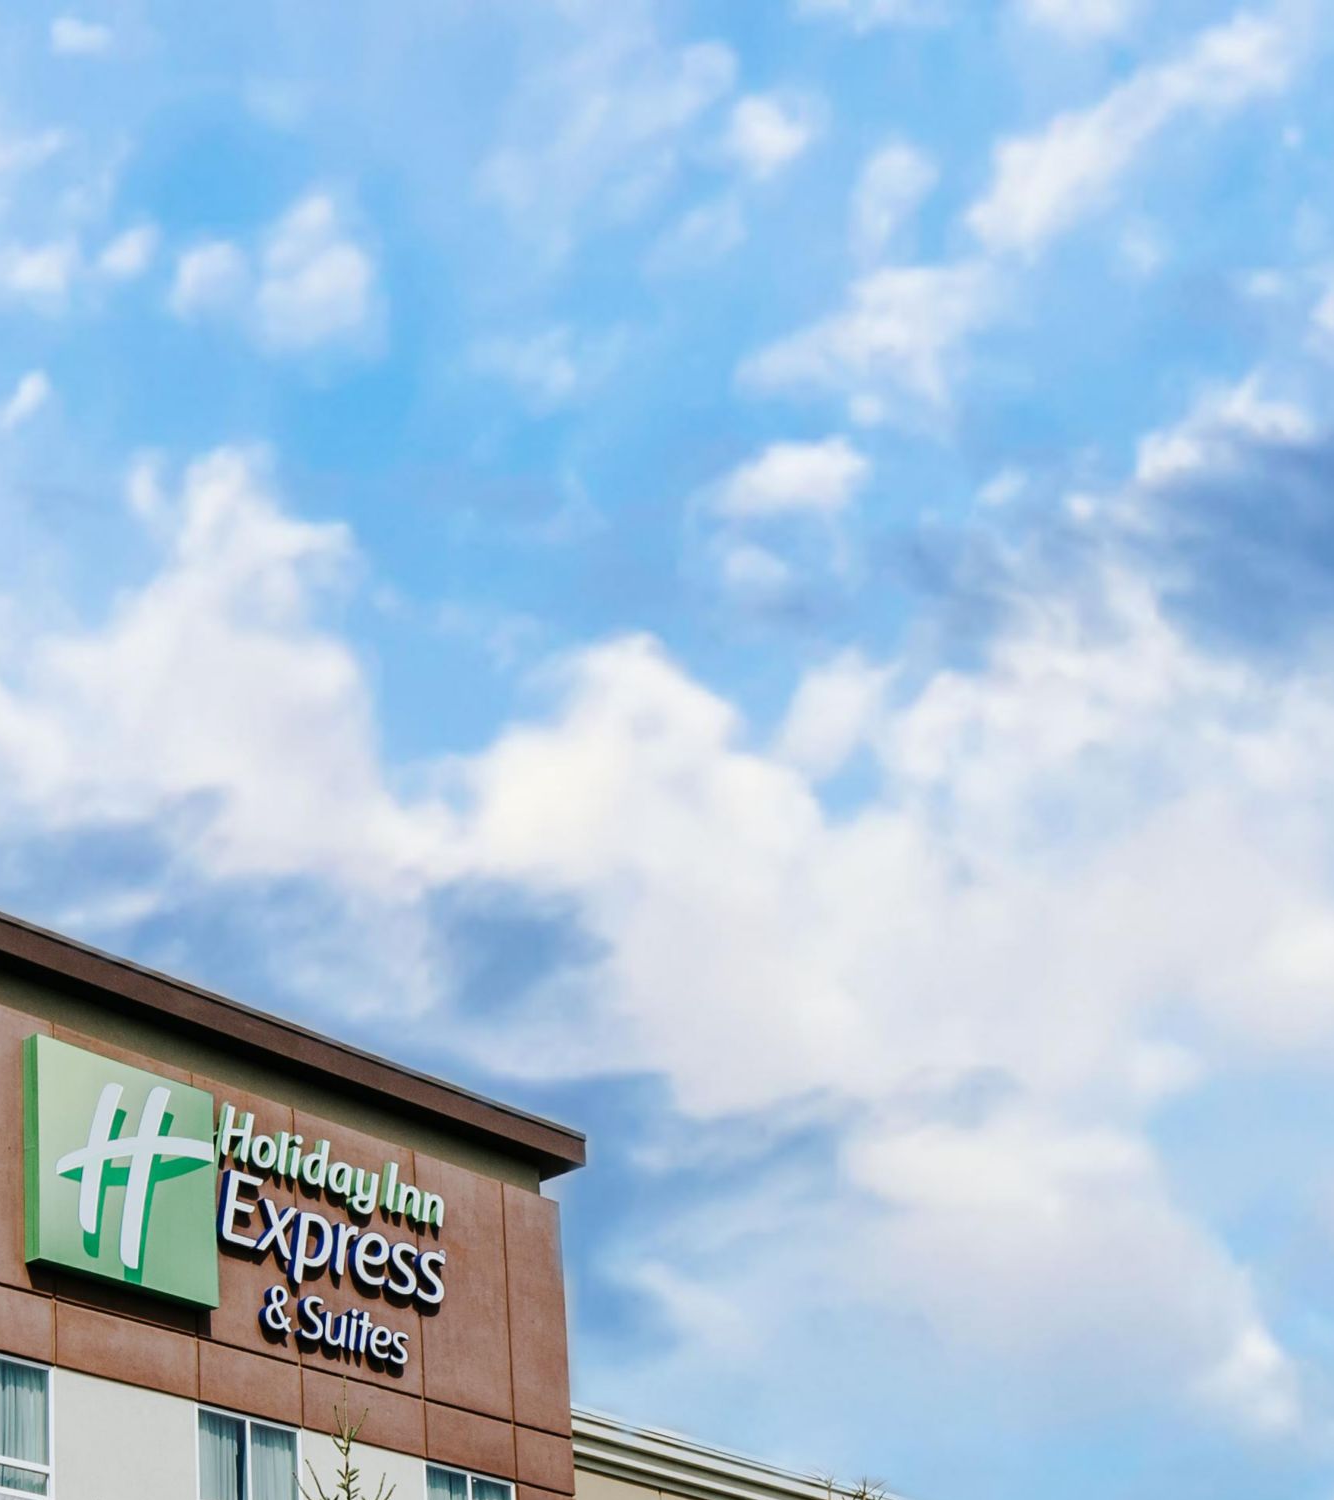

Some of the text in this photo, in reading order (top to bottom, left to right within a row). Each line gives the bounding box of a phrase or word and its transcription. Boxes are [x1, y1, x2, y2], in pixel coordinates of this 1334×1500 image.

[220, 1102, 446, 1228] Holiday Inn
[220, 1169, 447, 1305] Express
[264, 1284, 410, 1365] & Suites
